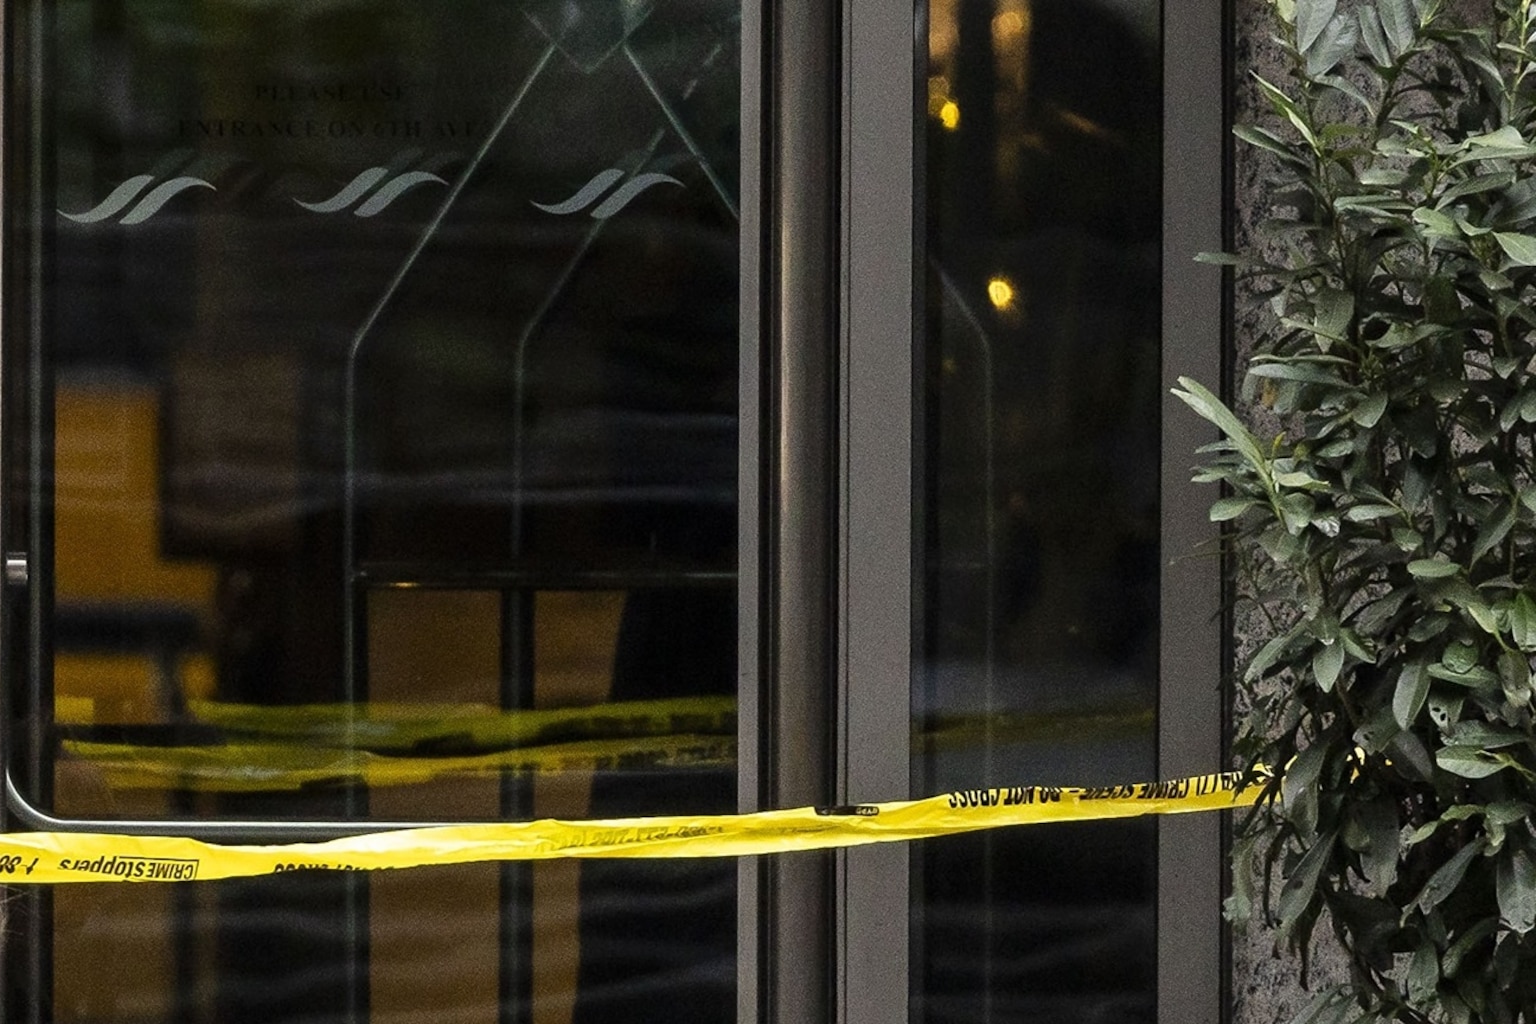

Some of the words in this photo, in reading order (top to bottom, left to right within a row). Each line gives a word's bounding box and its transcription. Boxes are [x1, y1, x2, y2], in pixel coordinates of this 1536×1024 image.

[255, 85, 347, 101] PLEASE
[180, 120, 317, 137] ENTRANCE
[330, 120, 363, 137] ON
[374, 120, 421, 137] 6TH
[1004, 786, 1035, 806] NOT
[1136, 778, 1190, 800] CRIME
